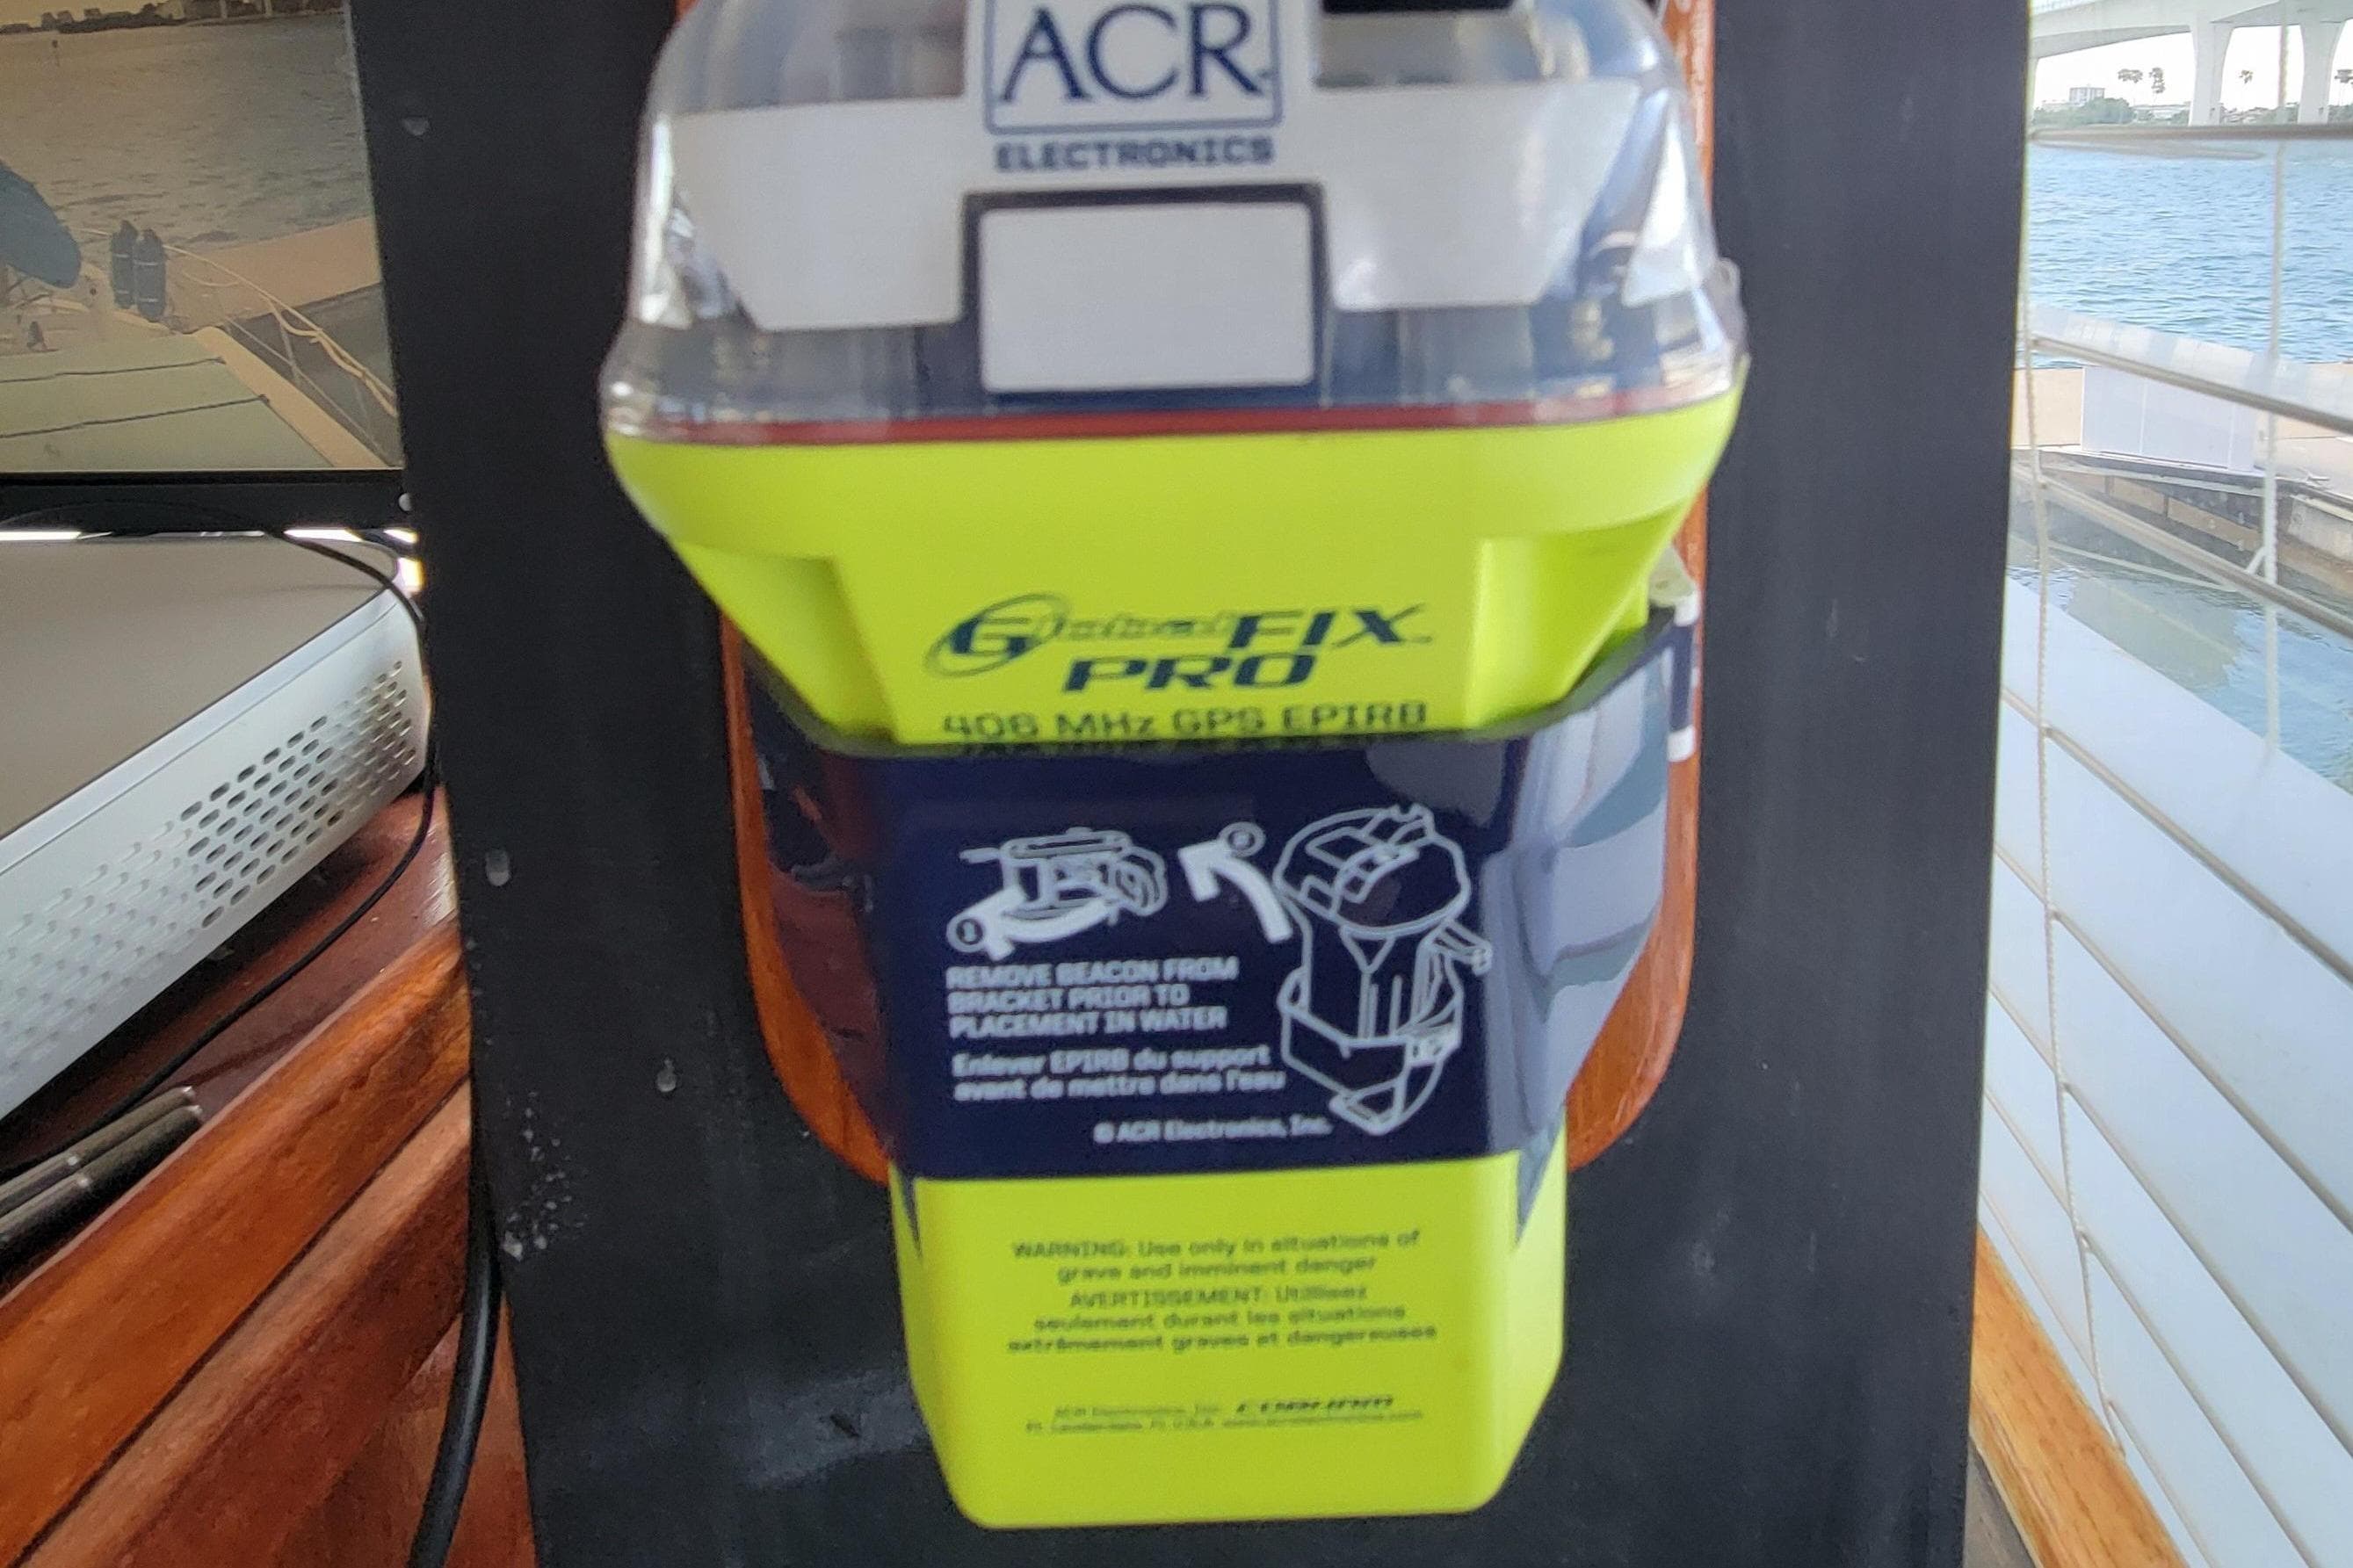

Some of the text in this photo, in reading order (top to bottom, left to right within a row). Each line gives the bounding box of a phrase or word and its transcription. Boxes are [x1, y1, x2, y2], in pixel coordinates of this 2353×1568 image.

[1000, 2, 1263, 102] ACR
[994, 136, 1275, 171] ELECTRONICS
[1063, 654, 1316, 692] PRO
[1055, 711, 1154, 738] MHz
[1172, 706, 1265, 734] GPS
[945, 956, 1240, 990] REMOVE BEACON FROM
[1068, 983, 1151, 1009] PRIOR
[1154, 983, 1190, 1006] TO
[949, 1006, 1227, 1038] PLACEMENT IN WATER
